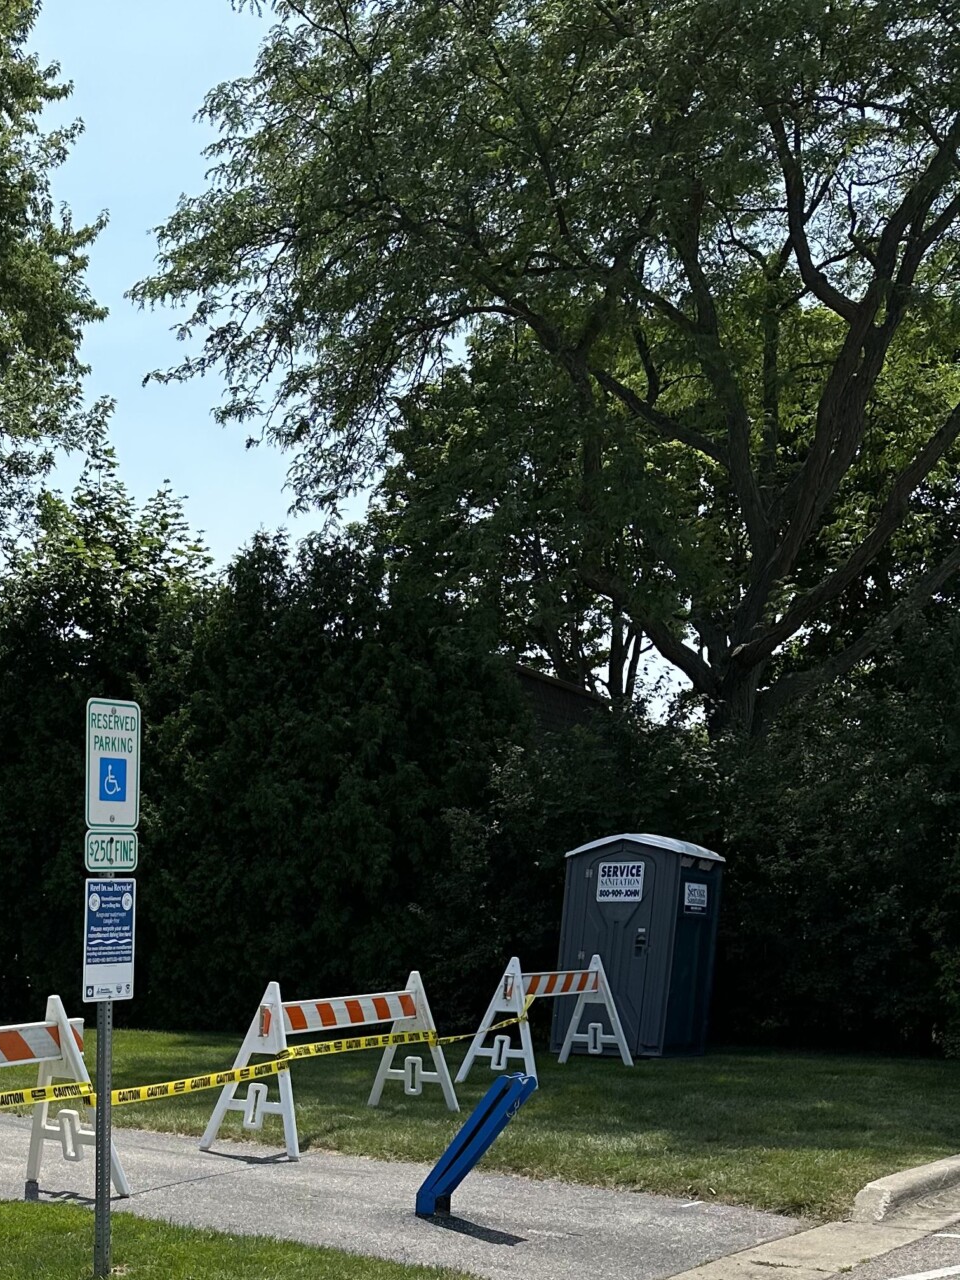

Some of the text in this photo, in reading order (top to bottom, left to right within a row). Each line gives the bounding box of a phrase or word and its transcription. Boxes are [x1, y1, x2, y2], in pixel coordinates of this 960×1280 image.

[91, 713, 136, 731] RESERVED
[94, 735, 133, 753] PARKING
[90, 840, 134, 862] $250 FINE
[601, 865, 641, 878] SERVICE
[600, 878, 640, 886] SANITATION
[599, 889, 640, 897] 800-909-JOHN
[118, 1089, 141, 1102] CAUTION
[147, 1084, 169, 1098] CAUTION
[191, 1077, 211, 1089] CAUTION
[216, 1071, 236, 1084] CAUTION
[254, 1063, 272, 1076] CAUTION
[53, 1084, 82, 1098] CAUTION
